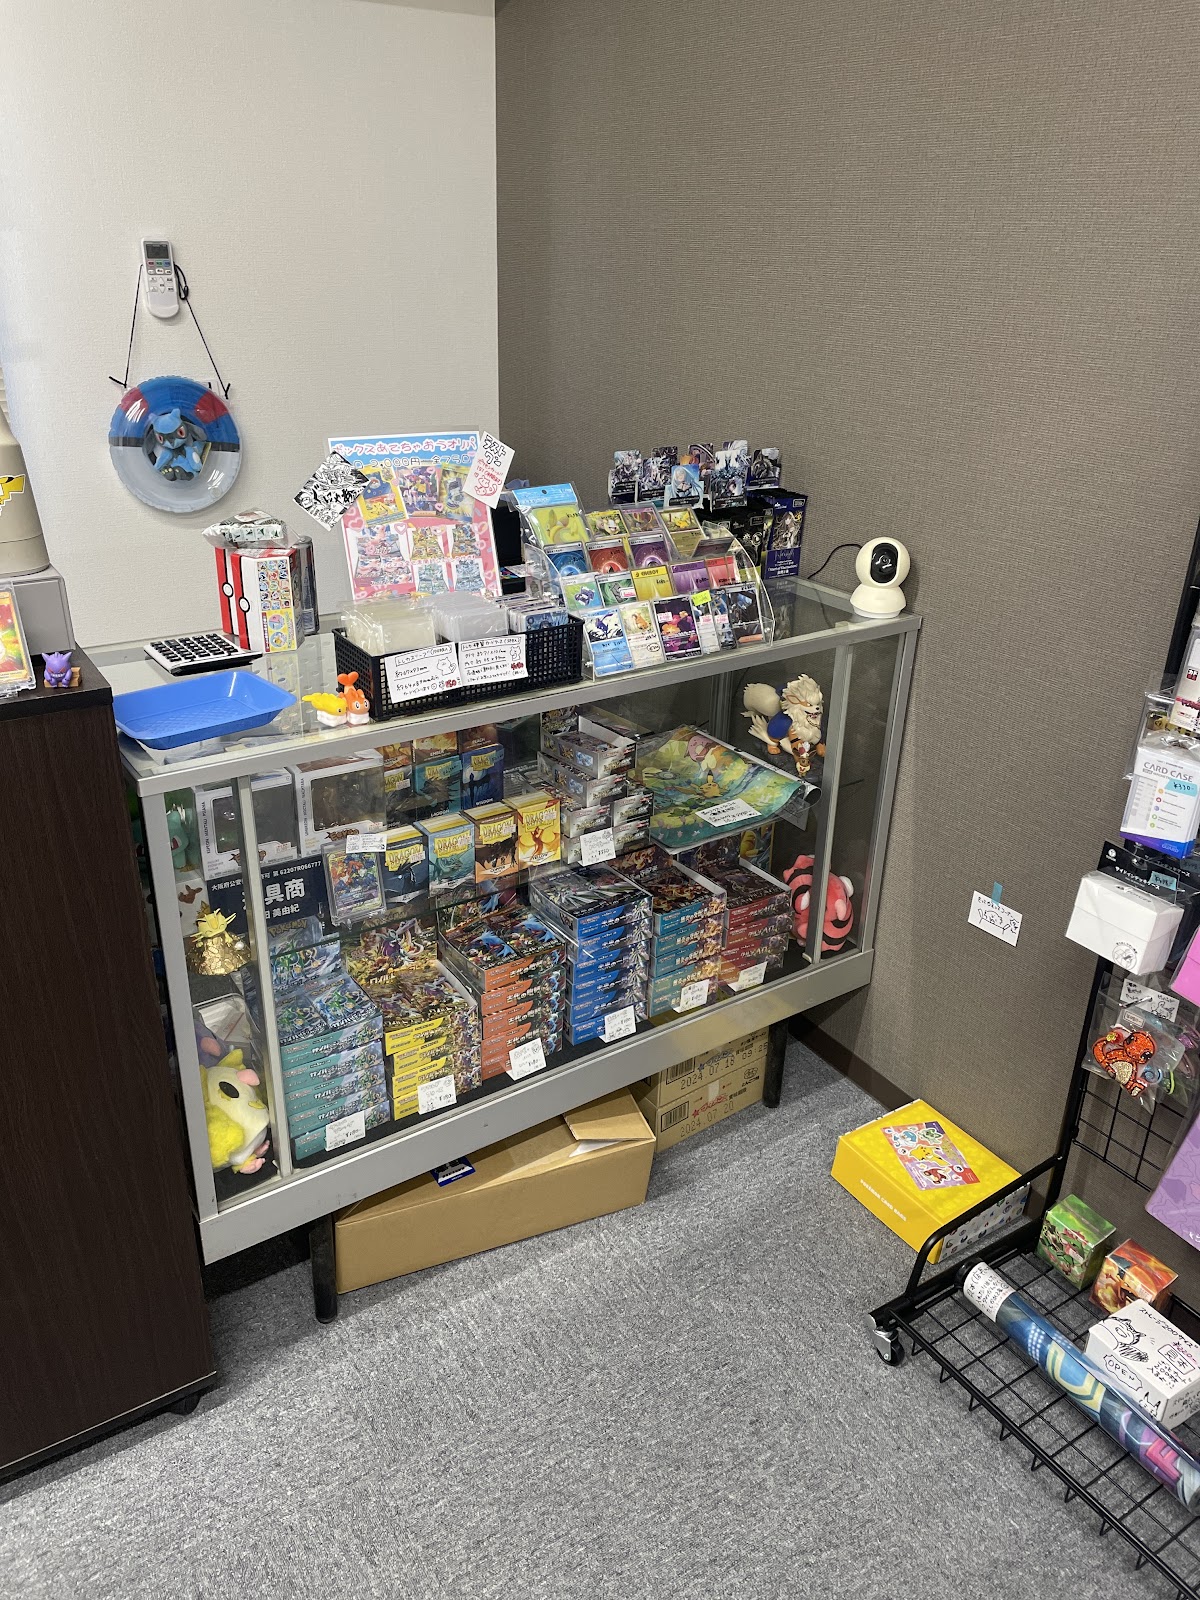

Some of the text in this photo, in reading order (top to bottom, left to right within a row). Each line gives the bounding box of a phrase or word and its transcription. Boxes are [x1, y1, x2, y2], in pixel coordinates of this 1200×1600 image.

[1143, 762, 1194, 782] CARD CASE
[211, 879, 243, 891] 大阪府公安
[272, 904, 299, 917] 美由紀
[1165, 1348, 1188, 1369] 見本
[1107, 1359, 1135, 1381] OPEN
